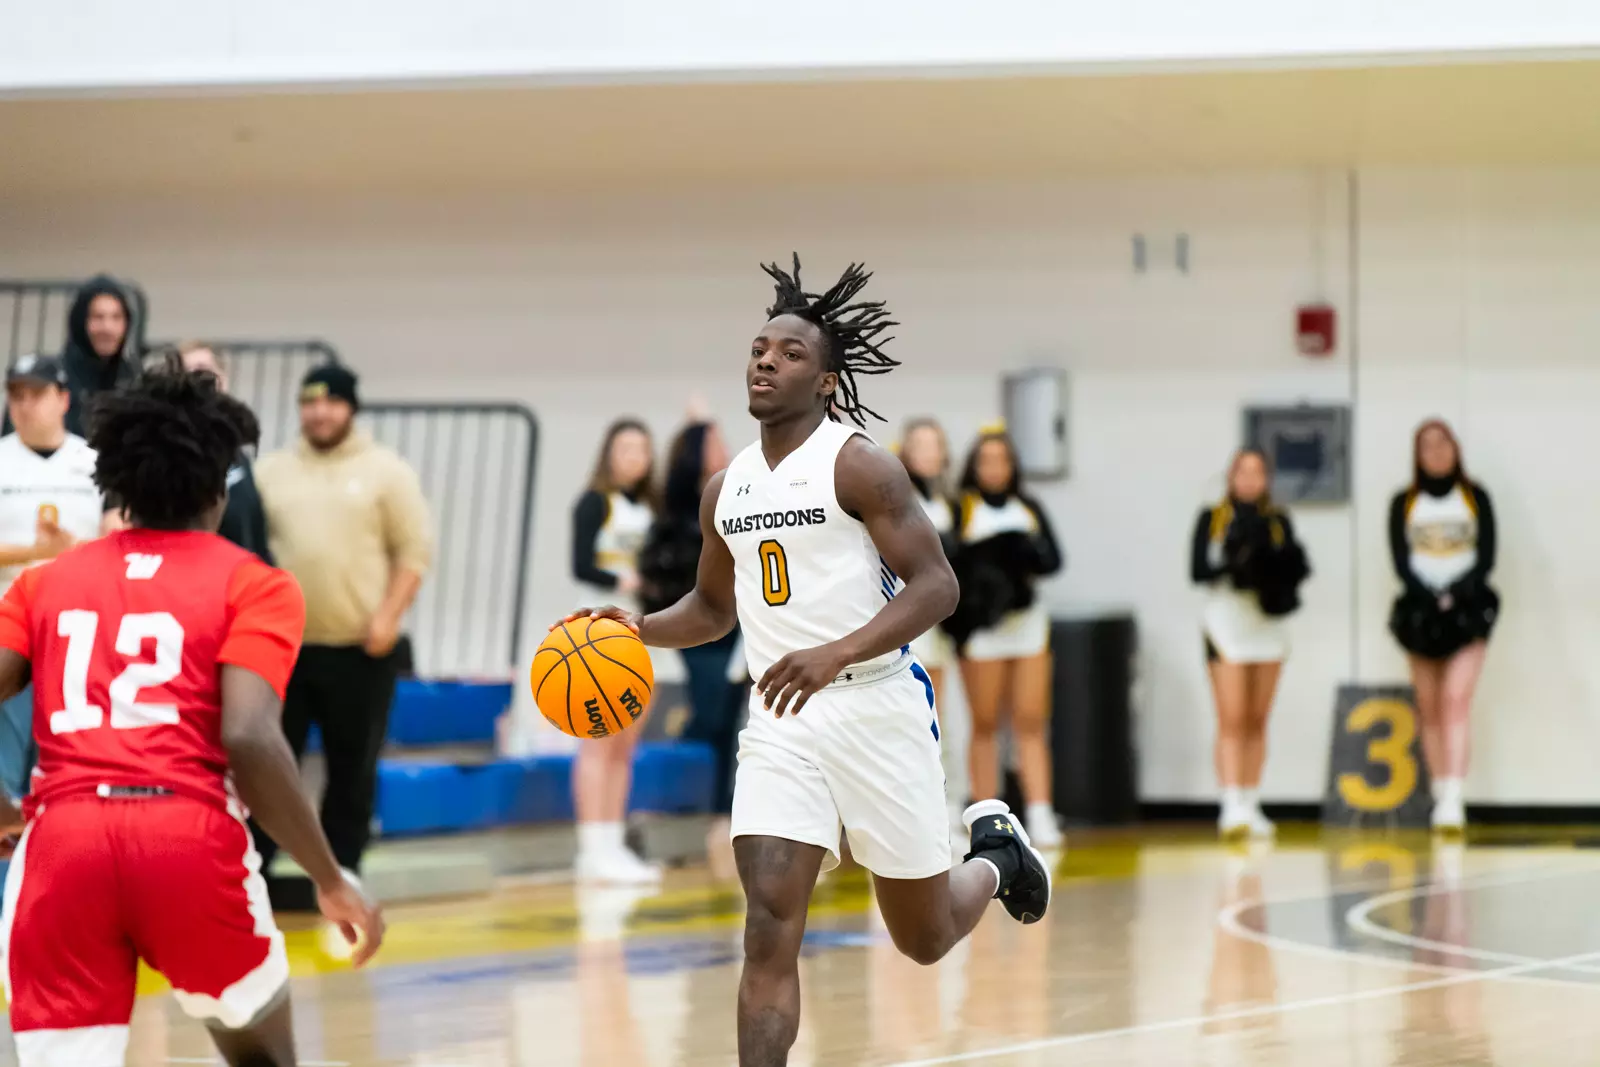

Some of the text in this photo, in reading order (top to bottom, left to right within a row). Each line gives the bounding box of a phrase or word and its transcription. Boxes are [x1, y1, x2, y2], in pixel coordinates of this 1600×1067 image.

[722, 508, 826, 535] MASTODONS
[758, 539, 791, 606] 0
[50, 609, 184, 735] 12
[619, 687, 643, 723] CAA
[1337, 697, 1419, 811] 3
